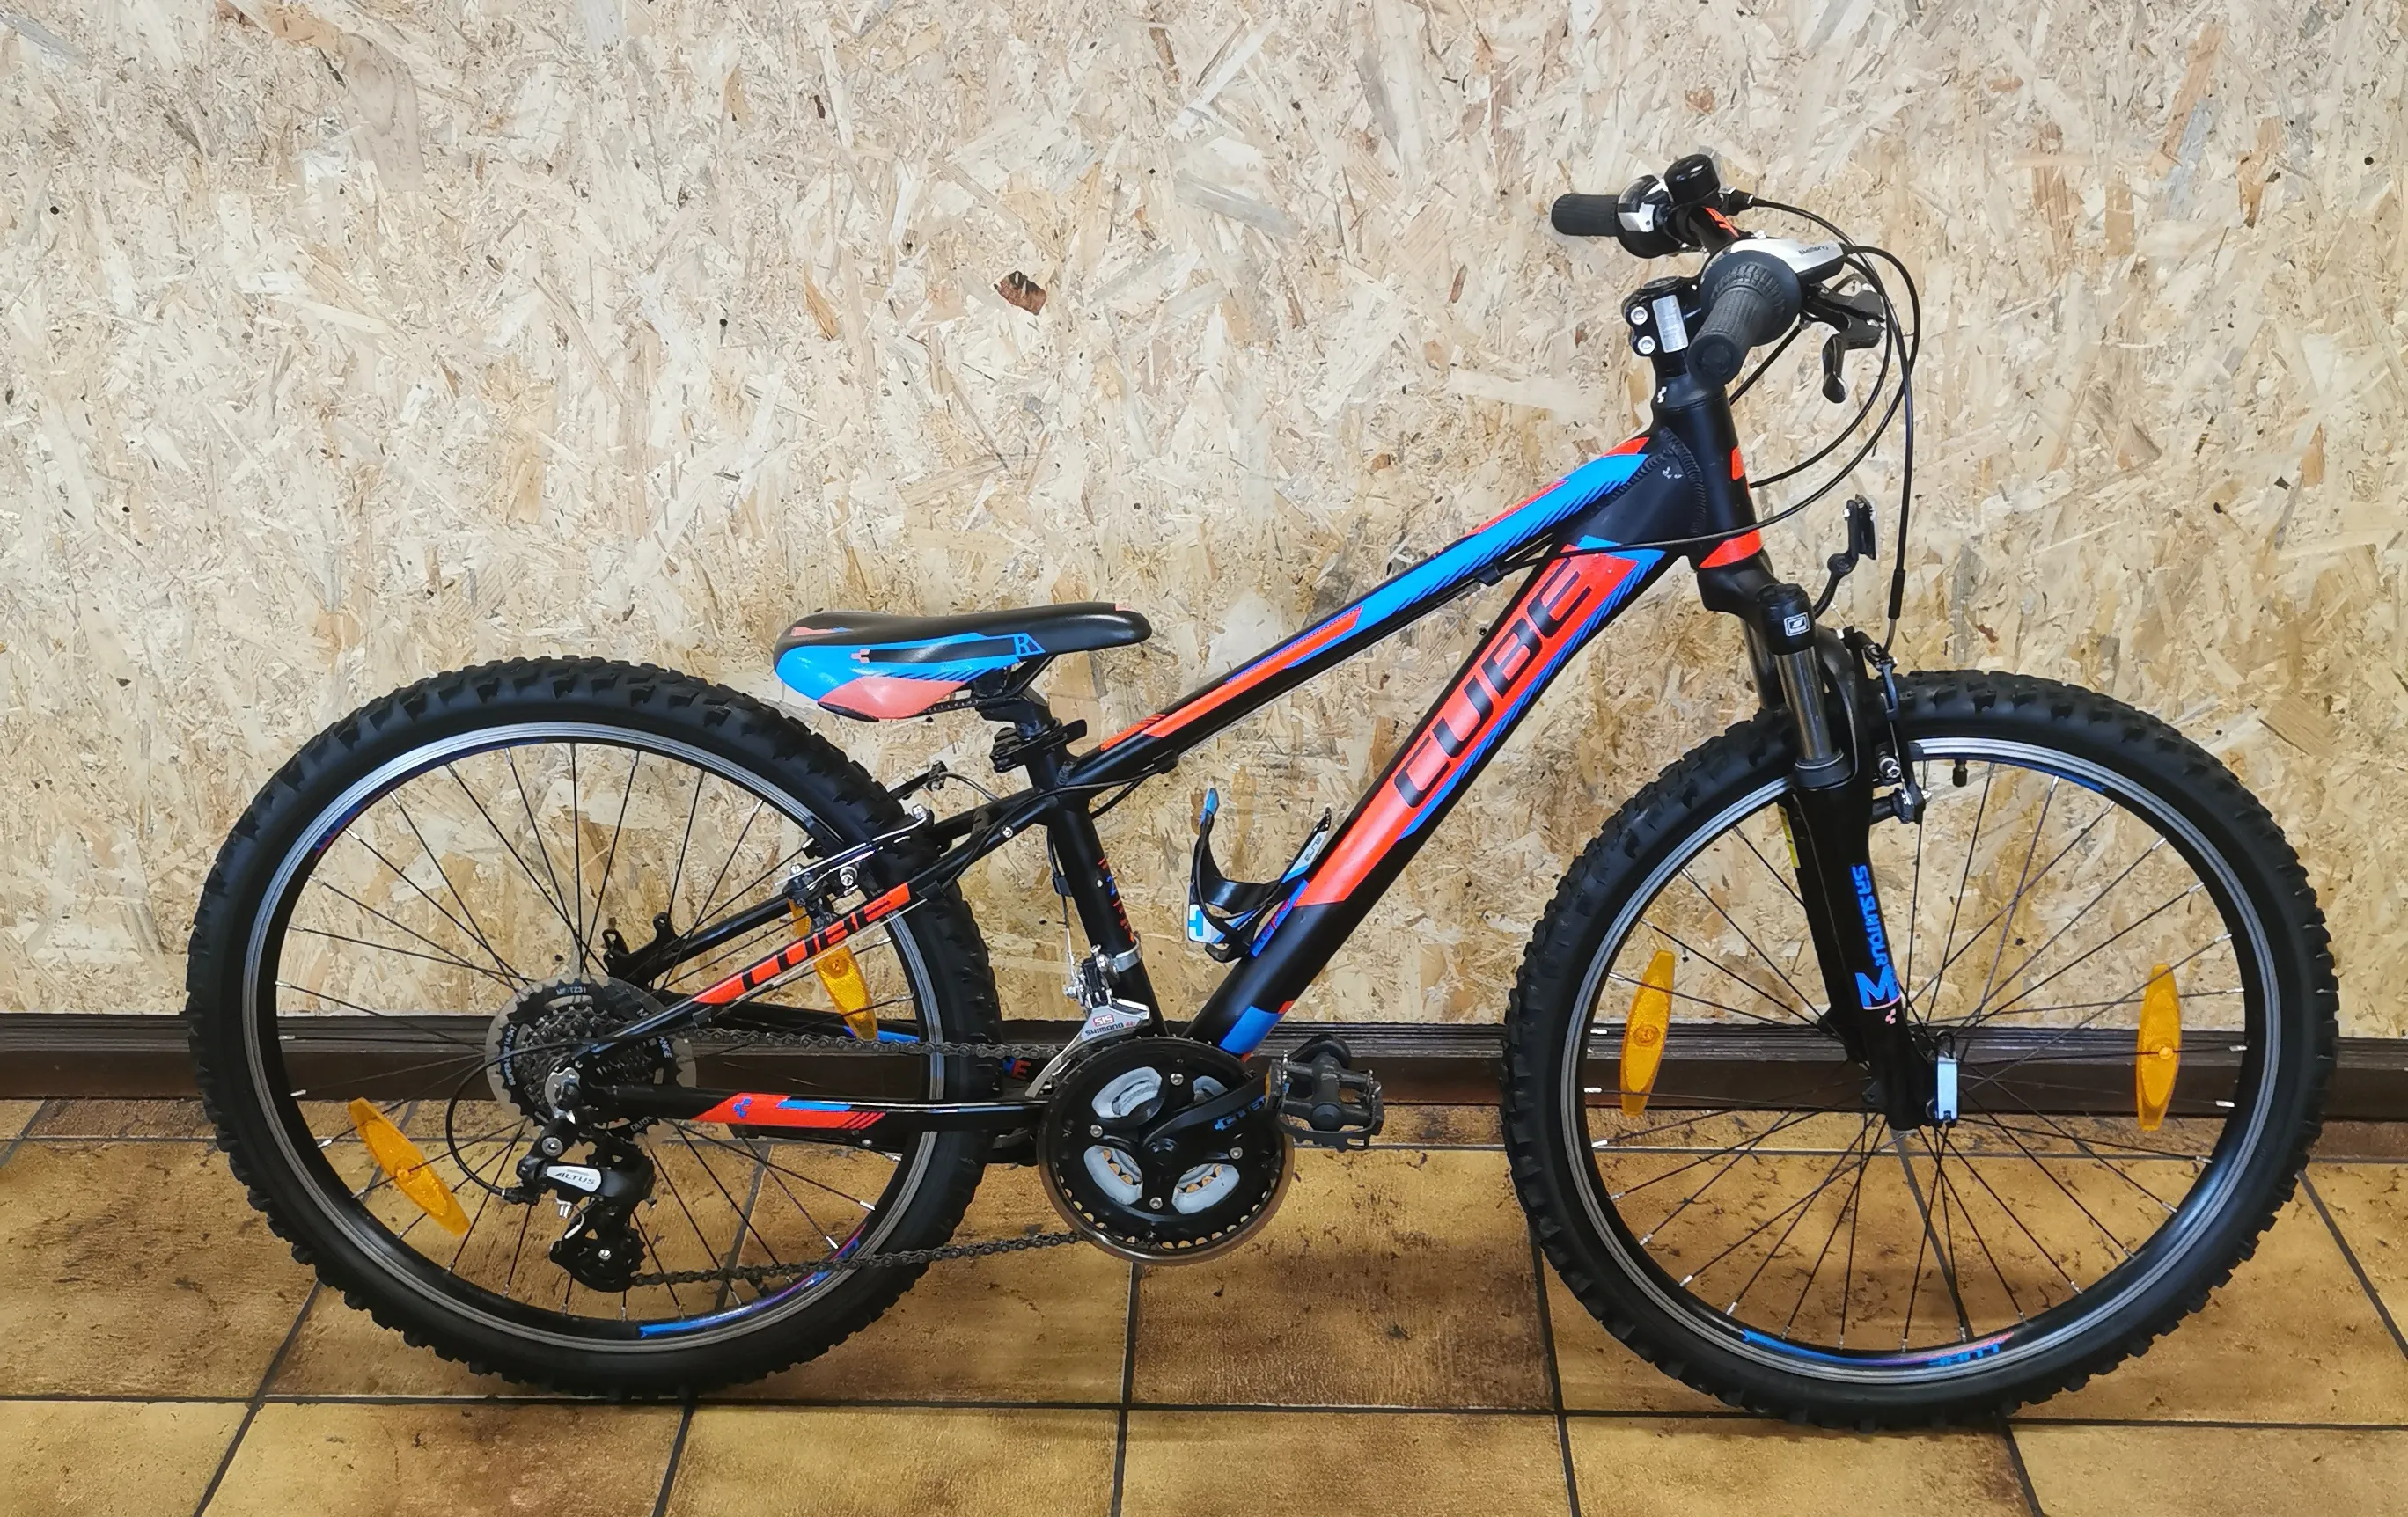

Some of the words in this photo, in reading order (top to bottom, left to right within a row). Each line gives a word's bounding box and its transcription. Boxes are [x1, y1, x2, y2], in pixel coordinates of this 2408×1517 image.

[1394, 558, 1592, 809] CUBE
[741, 890, 892, 991] CUBE
[1094, 1015, 1113, 1026] SIS
[1085, 1022, 1124, 1036] SHIMANO
[554, 1172, 595, 1184] ALTUS
